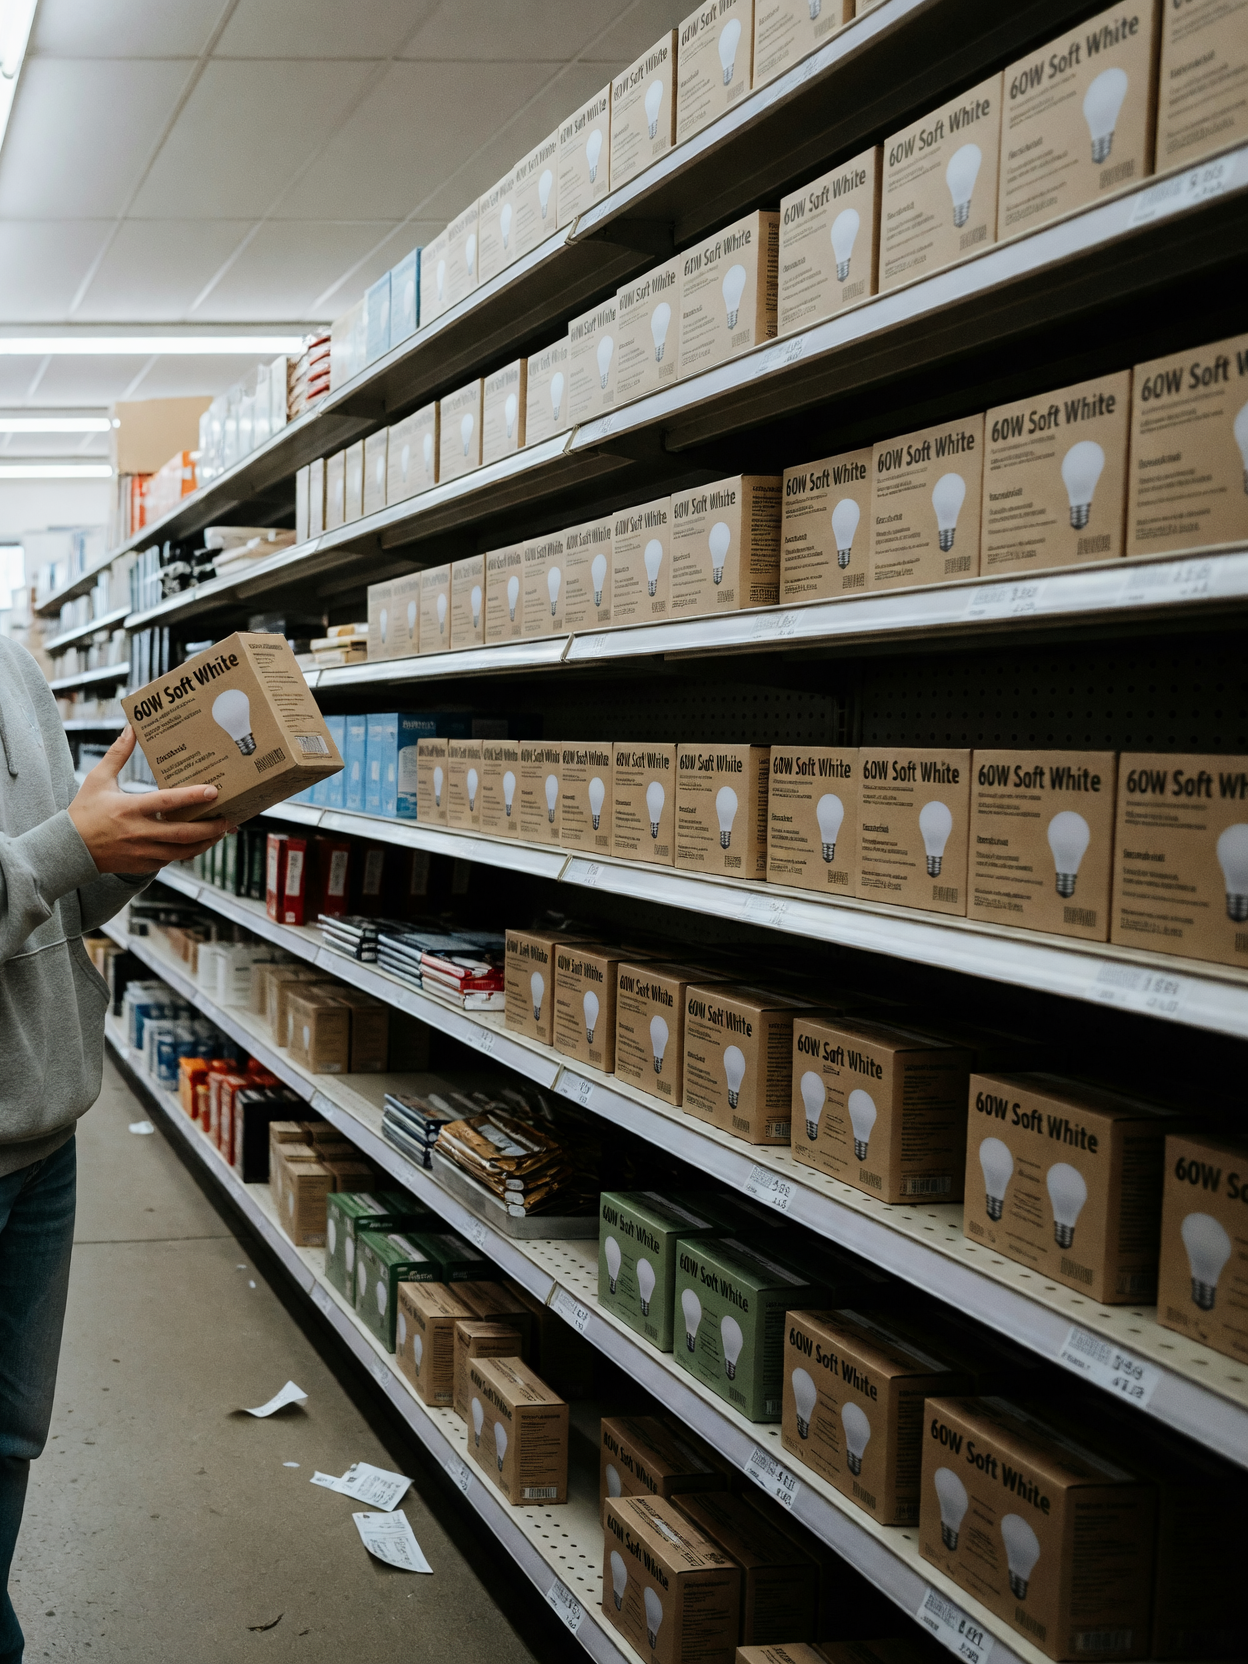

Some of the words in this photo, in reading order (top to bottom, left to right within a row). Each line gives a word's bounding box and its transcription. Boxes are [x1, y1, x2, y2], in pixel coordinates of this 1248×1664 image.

[1010, 60, 1045, 101] 60W
[1048, 41, 1081, 79] Soft
[1085, 15, 1139, 57] White
[889, 136, 916, 168] 60W
[918, 120, 944, 151] Soft
[949, 99, 990, 133] White
[784, 198, 806, 225] 60W
[809, 186, 830, 212] Soft
[832, 168, 866, 199] White
[723, 228, 752, 258] White
[1141, 367, 1183, 402] 60W
[1188, 354, 1230, 390] Soft
[992, 412, 1024, 442] 60W
[1028, 404, 1060, 435] Soft
[1064, 392, 1116, 424] White
[877, 447, 902, 473] 60W
[906, 440, 931, 466] Soft
[935, 431, 975, 458] White
[709, 489, 736, 512] White
[786, 473, 806, 496] 60W
[810, 468, 830, 491] Soft
[832, 461, 866, 487] White
[133, 691, 163, 722] 60W
[163, 675, 196, 705] Soft
[192, 652, 240, 686] White
[715, 753, 743, 773] White
[773, 756, 793, 776] 60W
[795, 756, 816, 777] Soft
[818, 757, 851, 779] White
[863, 760, 889, 780] 60W
[892, 760, 917, 782] Soft
[920, 761, 960, 784] White
[978, 764, 1010, 788] 60W
[1013, 764, 1045, 790] Soft
[1049, 765, 1101, 793] White
[1126, 768, 1168, 796] 60W
[1172, 769, 1213, 799] Soft
[688, 998, 706, 1019] 60W
[726, 1009, 752, 1037] White
[797, 1033, 820, 1059] 60W
[822, 1042, 845, 1069] Soft
[847, 1049, 883, 1081] White
[975, 1091, 1008, 1121] 60W
[1011, 1102, 1043, 1135] Soft
[1047, 1114, 1098, 1154] White
[1175, 1156, 1222, 1193] 60W
[1227, 1172, 1248, 1205] So
[680, 1252, 698, 1277] 60W
[700, 1265, 719, 1292] Soft
[719, 1277, 749, 1313] White
[789, 1327, 813, 1355] 60W
[815, 1344, 838, 1374] Soft
[841, 1360, 878, 1402] White
[931, 1418, 962, 1455] 60W
[966, 1441, 998, 1481] Soft
[1001, 1462, 1051, 1516] White
